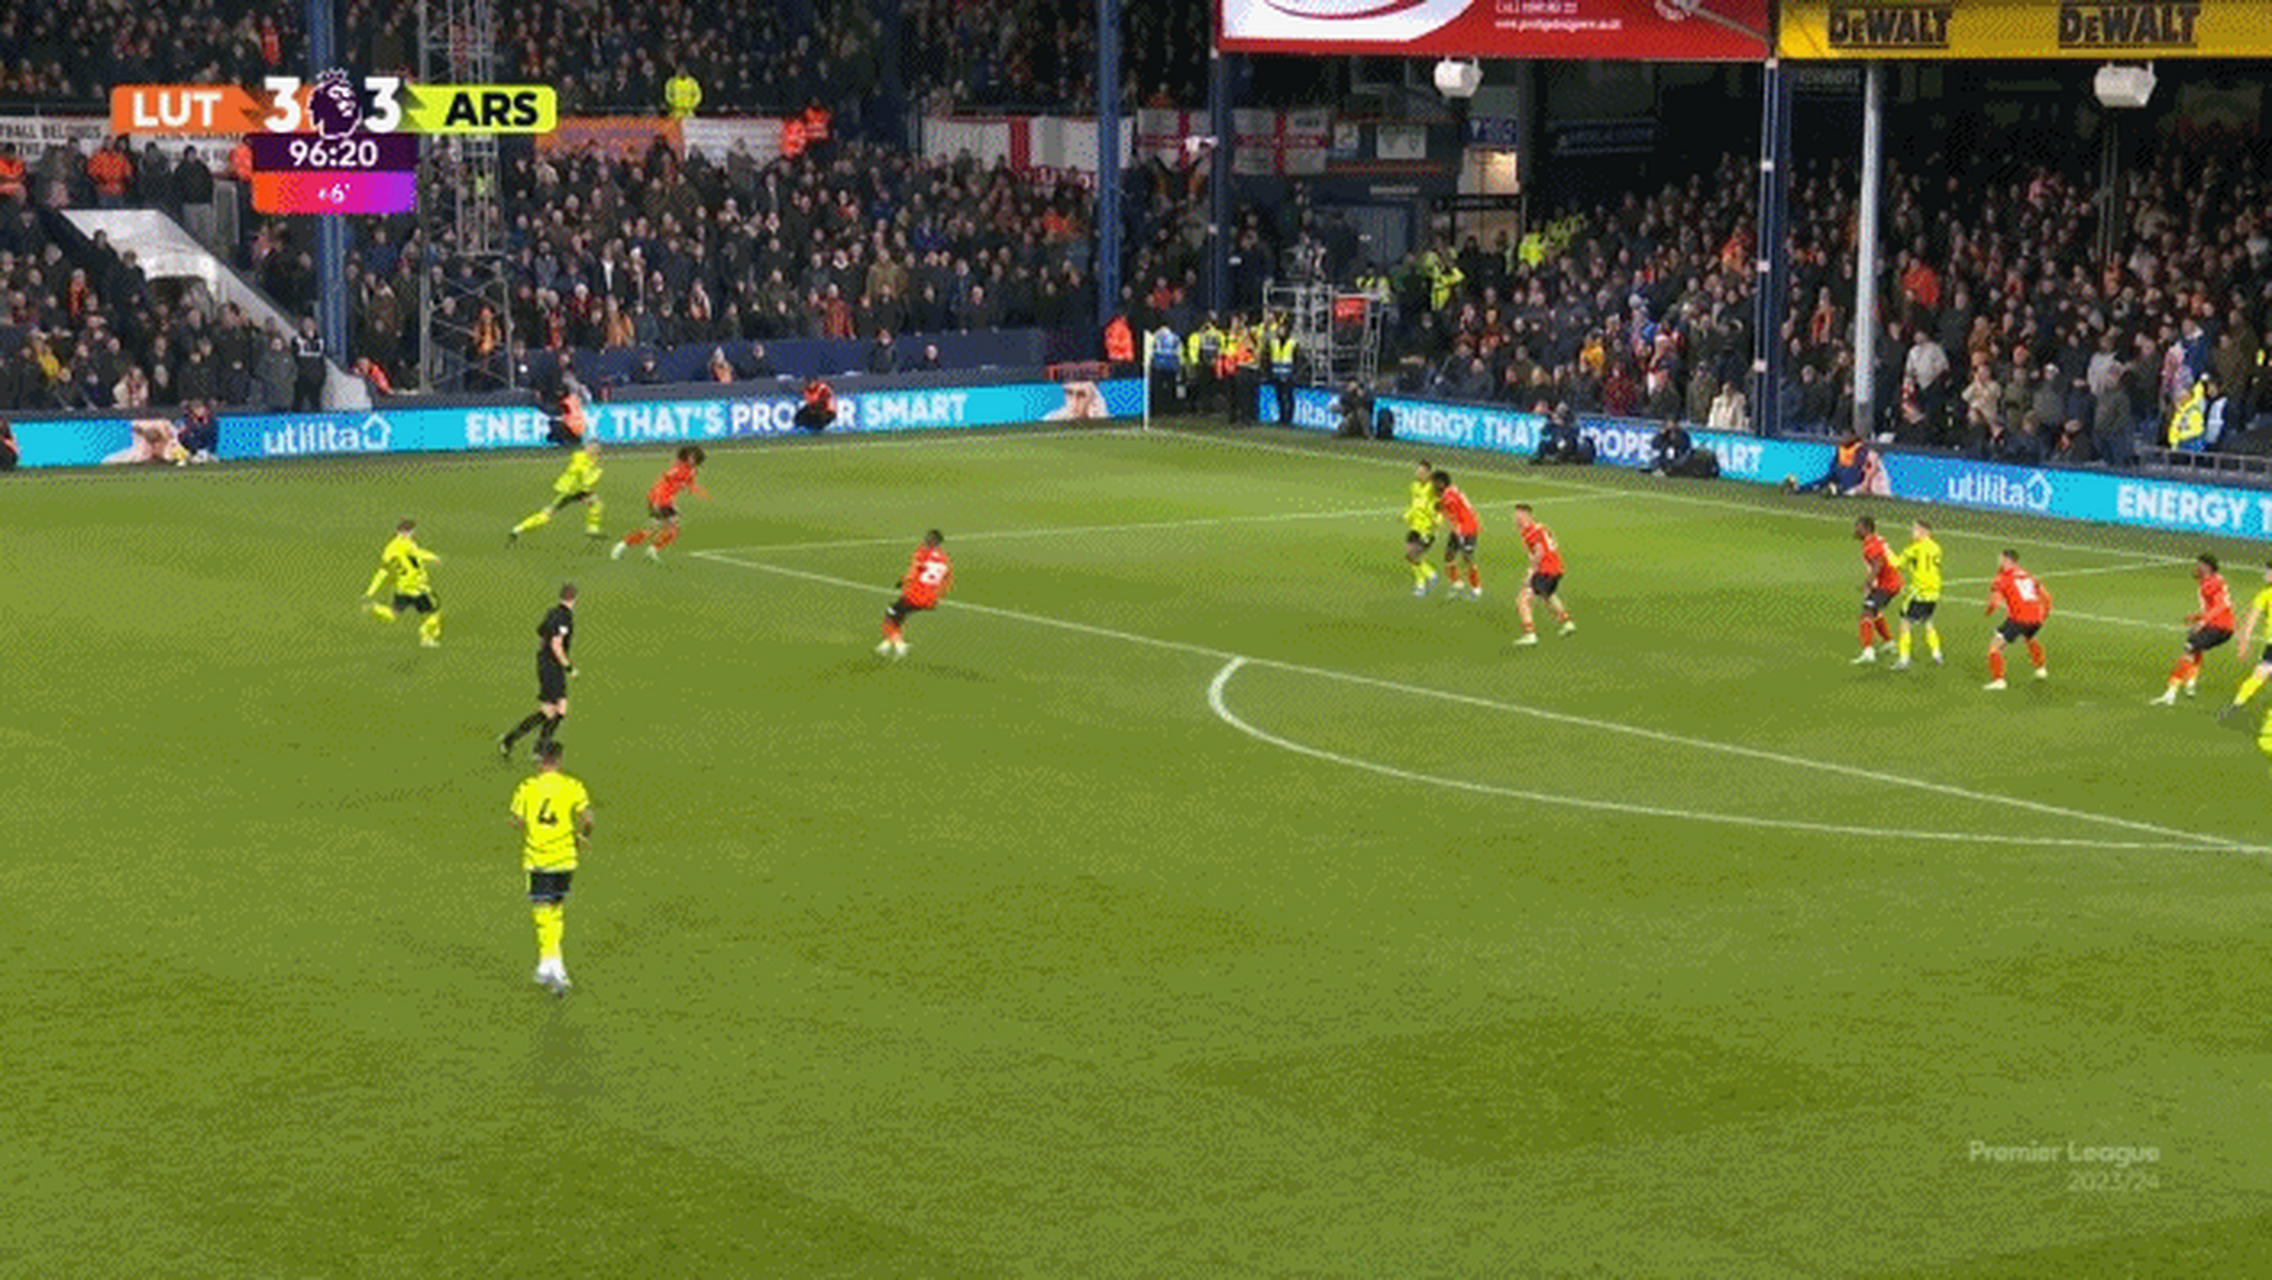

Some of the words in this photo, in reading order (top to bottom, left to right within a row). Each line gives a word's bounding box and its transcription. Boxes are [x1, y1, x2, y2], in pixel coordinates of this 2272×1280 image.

[263, 418, 360, 455] utilita
[466, 405, 602, 445] ENERY
[611, 400, 724, 438] THAT'S
[731, 397, 856, 433] PROR
[864, 393, 967, 427] SMART
[1948, 472, 2025, 505] utilita
[2116, 483, 2248, 529] ENERGY
[538, 798, 559, 825] 4
